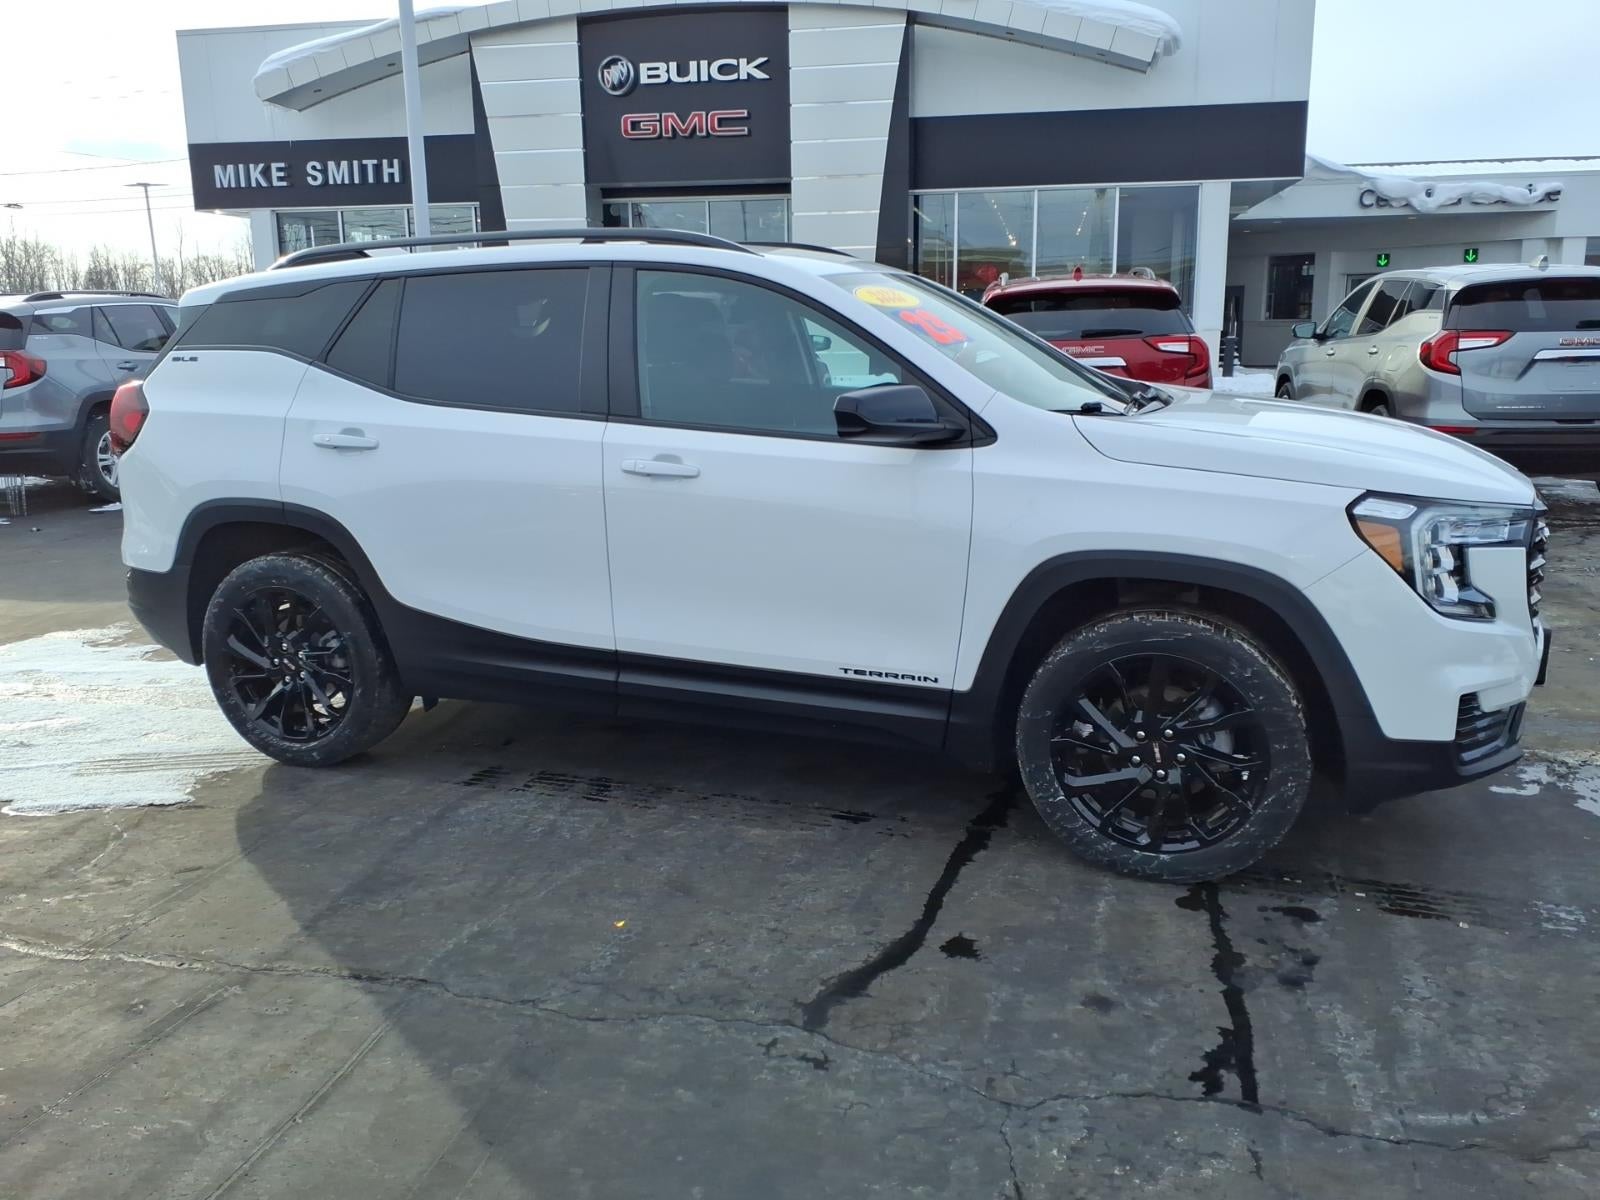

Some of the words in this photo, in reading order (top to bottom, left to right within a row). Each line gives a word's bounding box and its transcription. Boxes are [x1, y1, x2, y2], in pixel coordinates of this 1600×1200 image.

[639, 56, 771, 85] BUICK
[620, 108, 749, 139] GMC
[213, 161, 289, 189] MIKE
[305, 158, 401, 187] SMITH
[838, 667, 939, 684] TERRAIN
